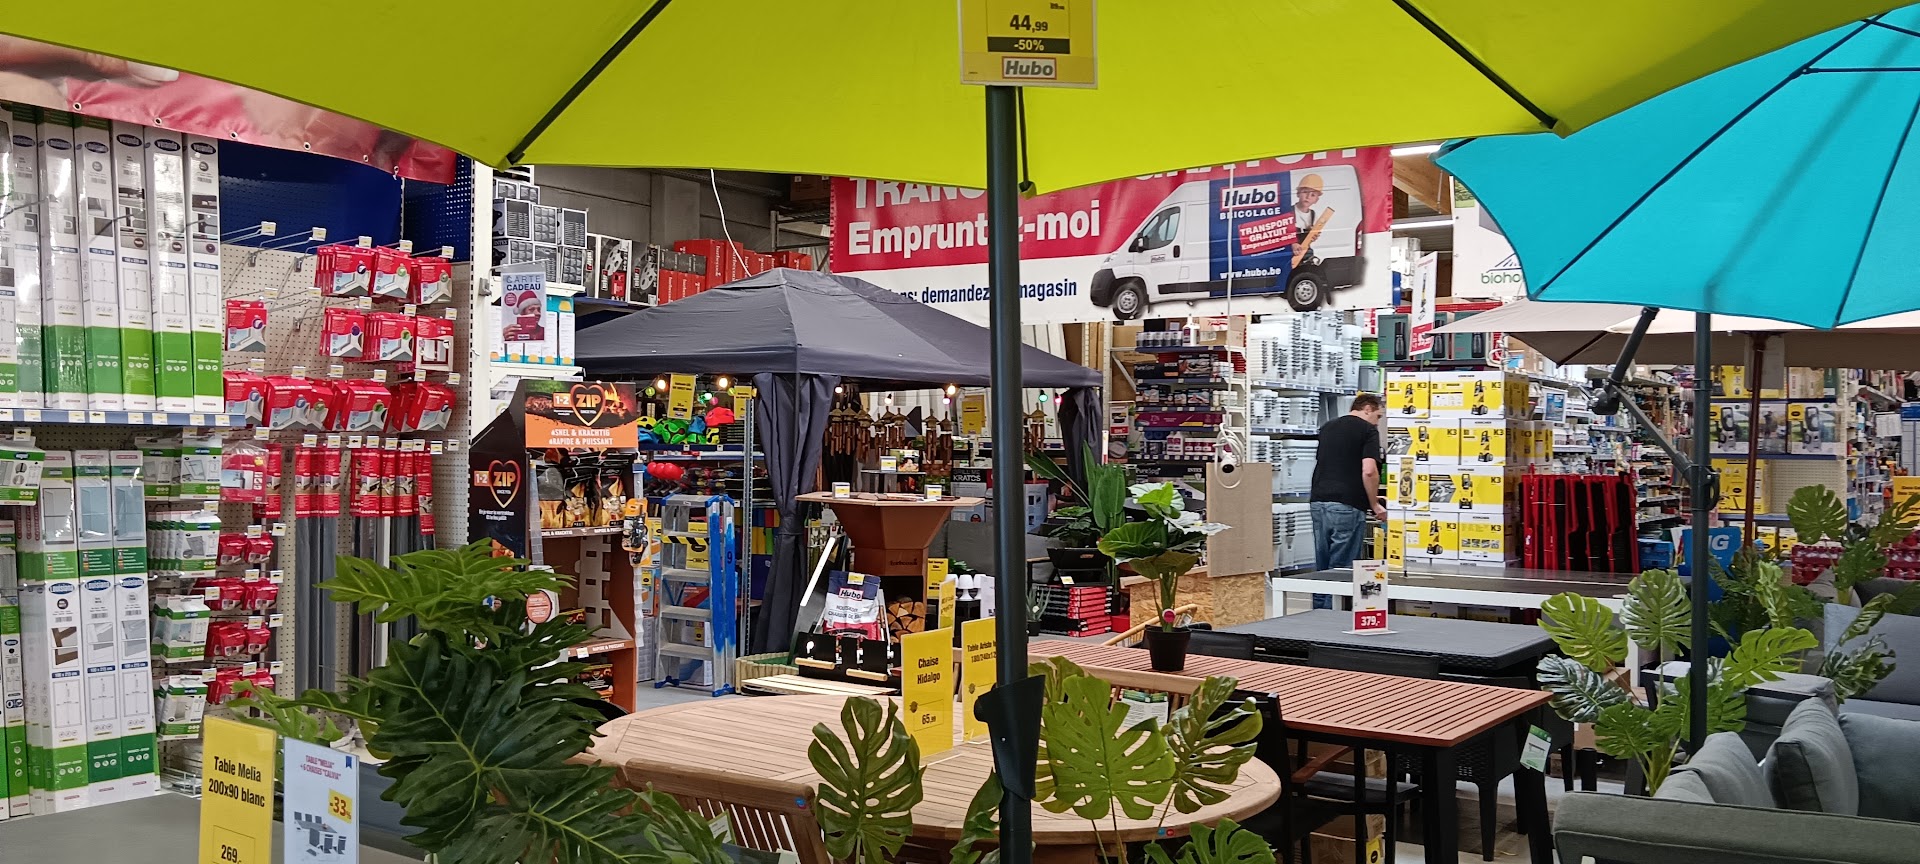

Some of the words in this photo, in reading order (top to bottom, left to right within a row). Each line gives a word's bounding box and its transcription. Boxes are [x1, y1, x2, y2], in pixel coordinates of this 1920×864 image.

[1009, 14, 1048, 33] 44,99
[1013, 39, 1045, 52] -50%
[1005, 60, 1054, 76] Hubo
[1224, 188, 1277, 207] Hubo
[848, 200, 1101, 259] Emprunt-moi
[1239, 216, 1295, 237] TRANSPORT
[1248, 227, 1288, 243] GRATUIT
[506, 275, 541, 284] CARTE
[1481, 272, 1522, 284] bioho
[506, 283, 541, 291] CADEAU
[921, 284, 991, 305] demandez
[575, 394, 602, 408] ZIP
[578, 429, 610, 437] KRACHTIG
[1446, 428, 1457, 436] K3
[1493, 428, 1504, 436] K3
[575, 438, 581, 446] &
[582, 438, 614, 446] PUISSANT
[493, 472, 517, 487] ZIP
[1417, 474, 1428, 482] K3
[1490, 476, 1502, 484] K3
[1446, 522, 1457, 530] K3
[840, 589, 862, 600] Hubo
[917, 656, 940, 669] Chaise
[917, 671, 941, 685] Hidalgo
[214, 755, 236, 776] Table
[238, 762, 262, 783] Melia
[208, 778, 239, 800] 200x90
[241, 787, 265, 808] blanc
